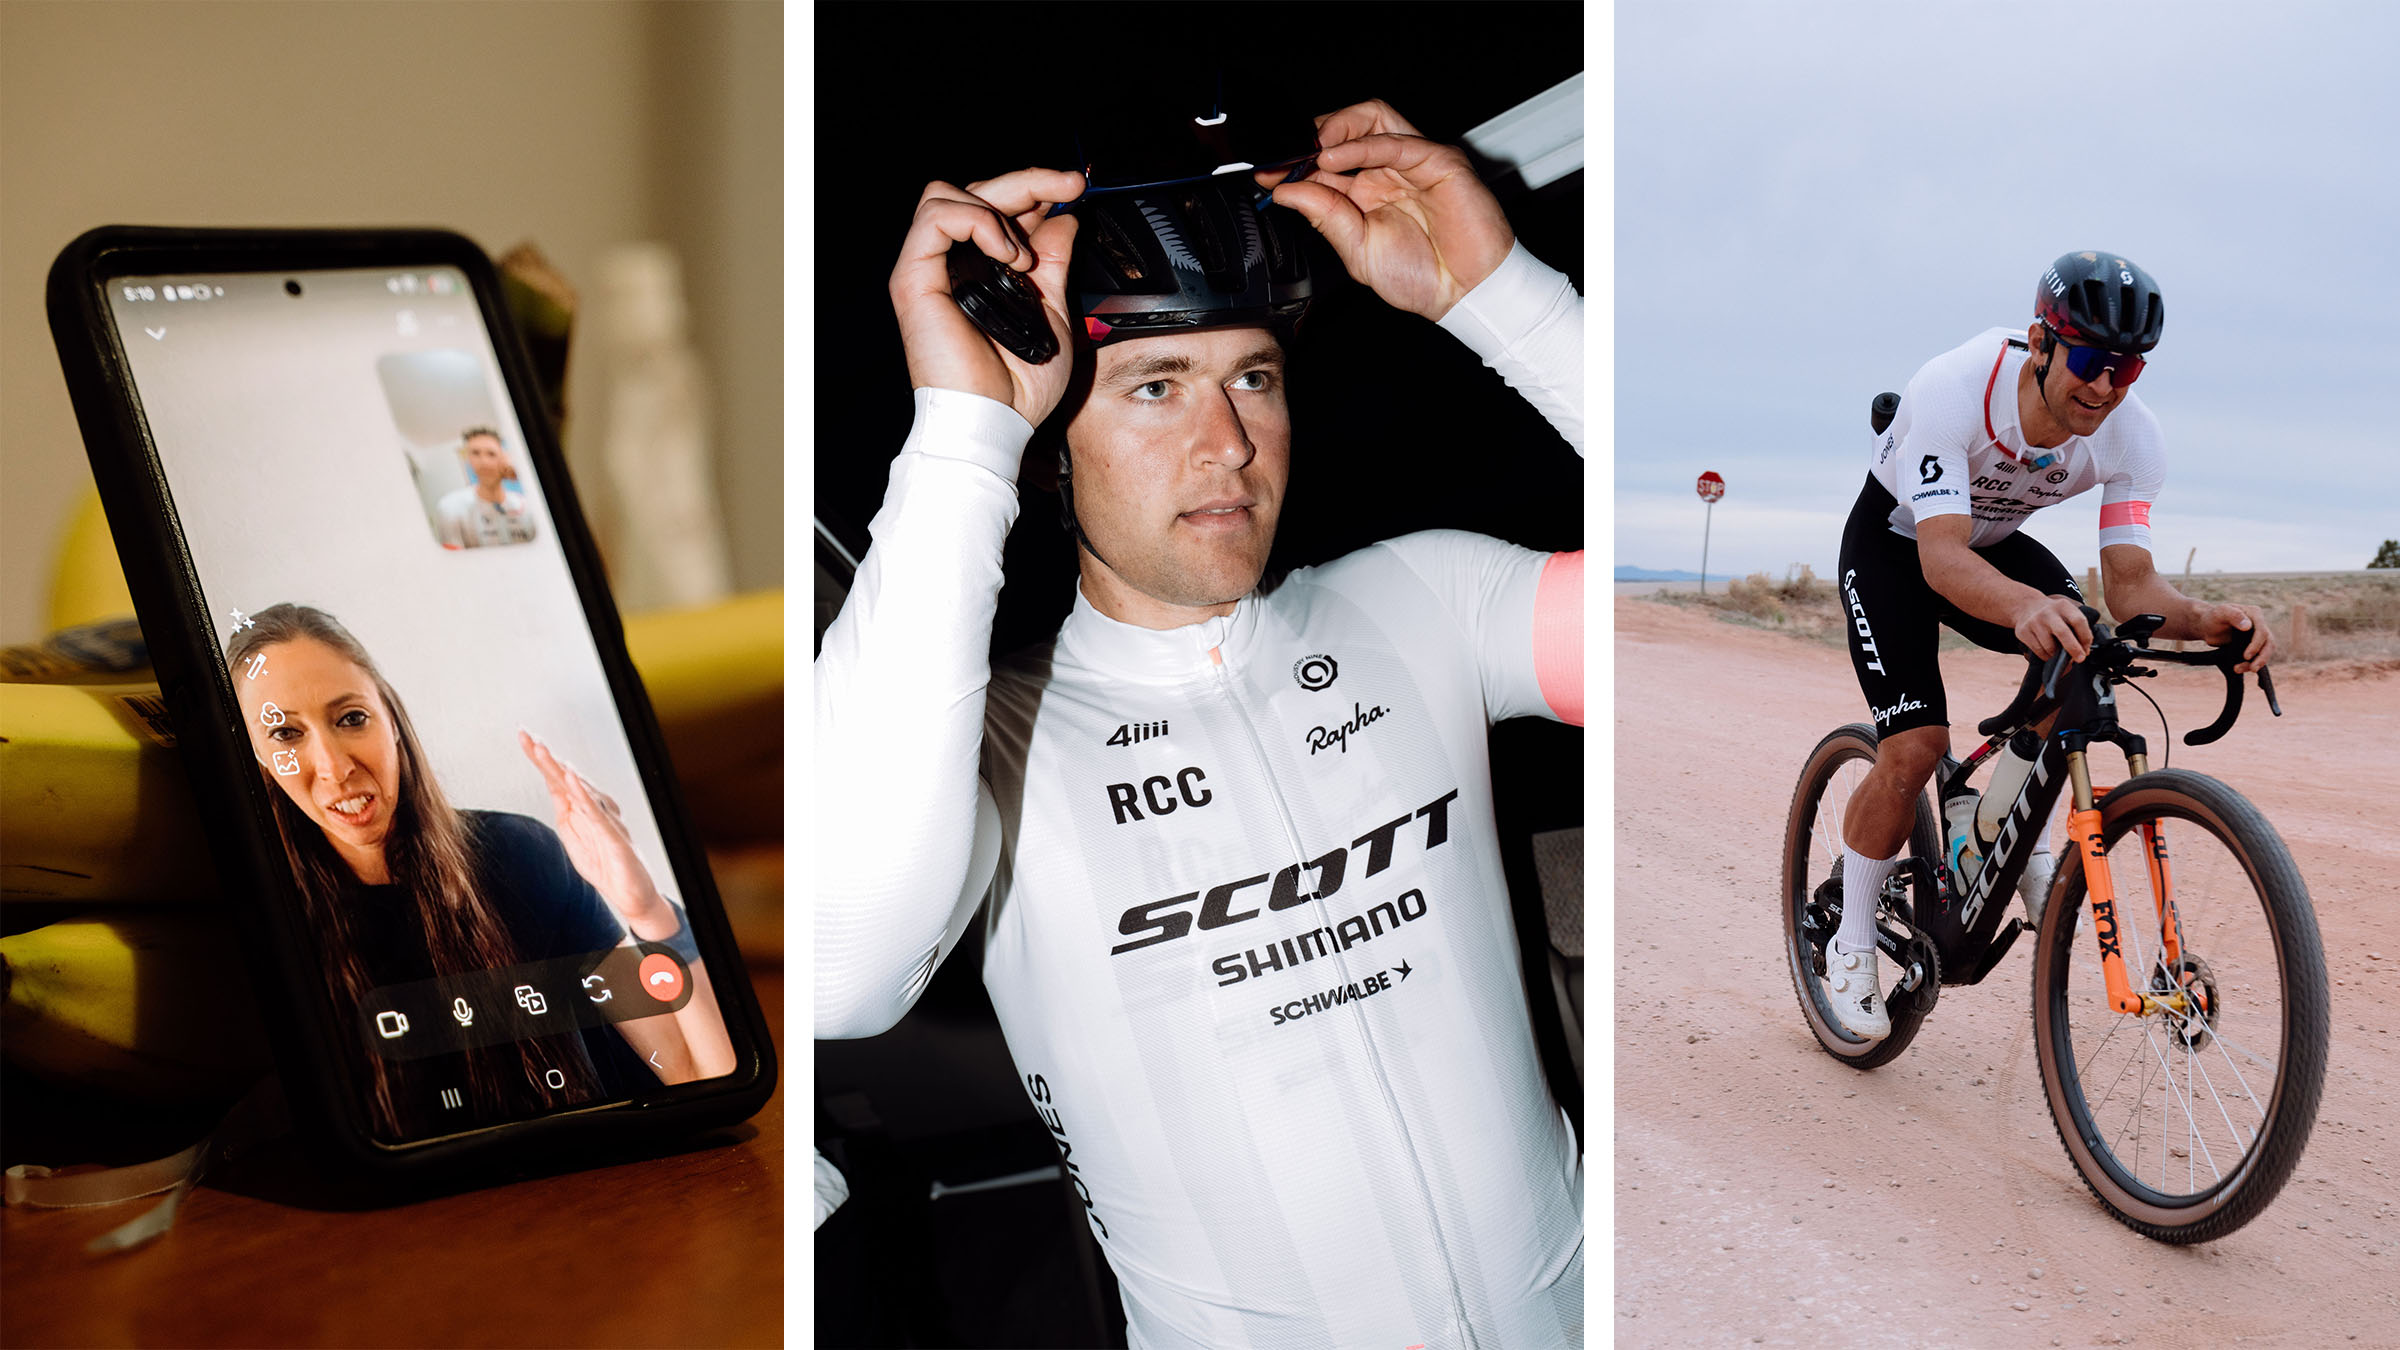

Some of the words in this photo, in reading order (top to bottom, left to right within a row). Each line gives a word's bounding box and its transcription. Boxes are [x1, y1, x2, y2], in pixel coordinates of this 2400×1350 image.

[1971, 476, 2012, 491] RCC
[1848, 587, 1886, 676] SCOTT
[1106, 720, 1169, 748] 4iiii
[1106, 766, 1213, 825] RCC
[1961, 740, 2049, 933] SCOTT
[1110, 787, 1459, 957] SCOTT
[1211, 888, 1427, 988] SHIMANO
[2092, 899, 2122, 963] FOX
[1269, 970, 1392, 1026] SCHWALBE
